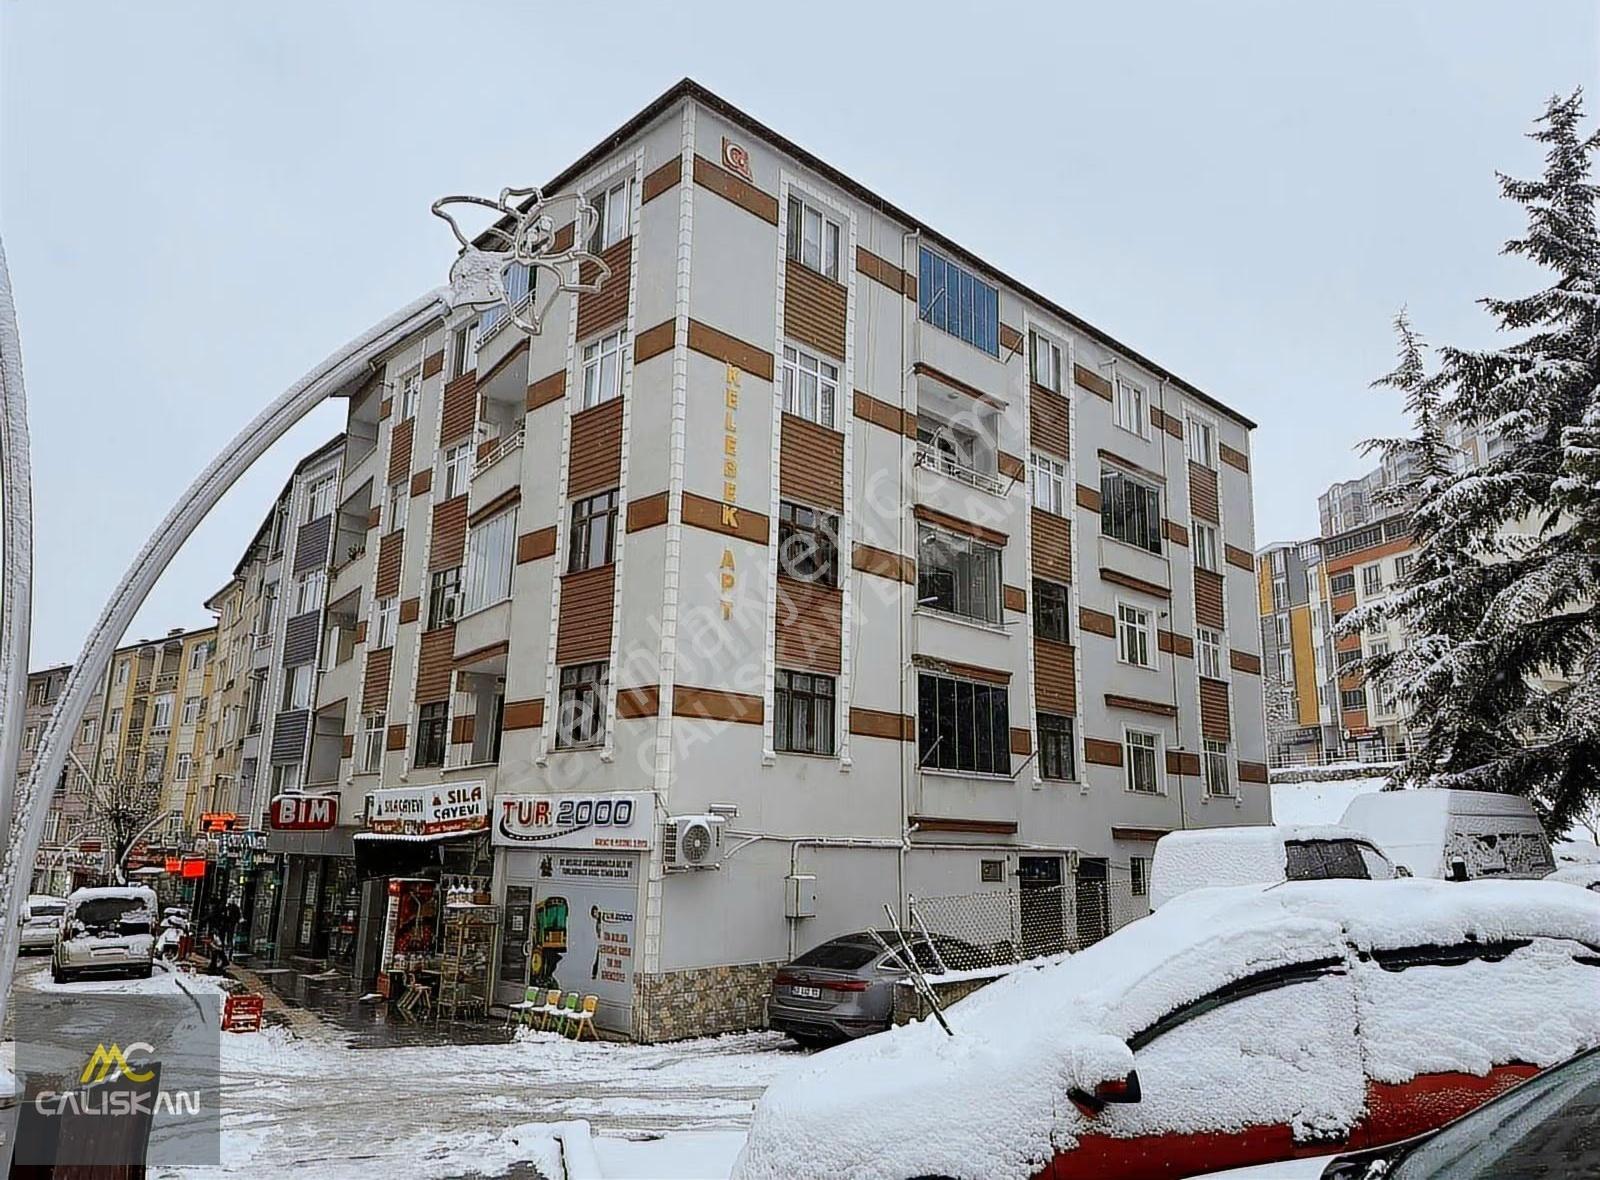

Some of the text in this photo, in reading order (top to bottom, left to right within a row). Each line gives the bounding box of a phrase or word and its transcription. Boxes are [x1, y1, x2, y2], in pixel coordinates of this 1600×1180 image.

[719, 548, 735, 621] APT
[502, 800, 633, 826] TUR 2000
